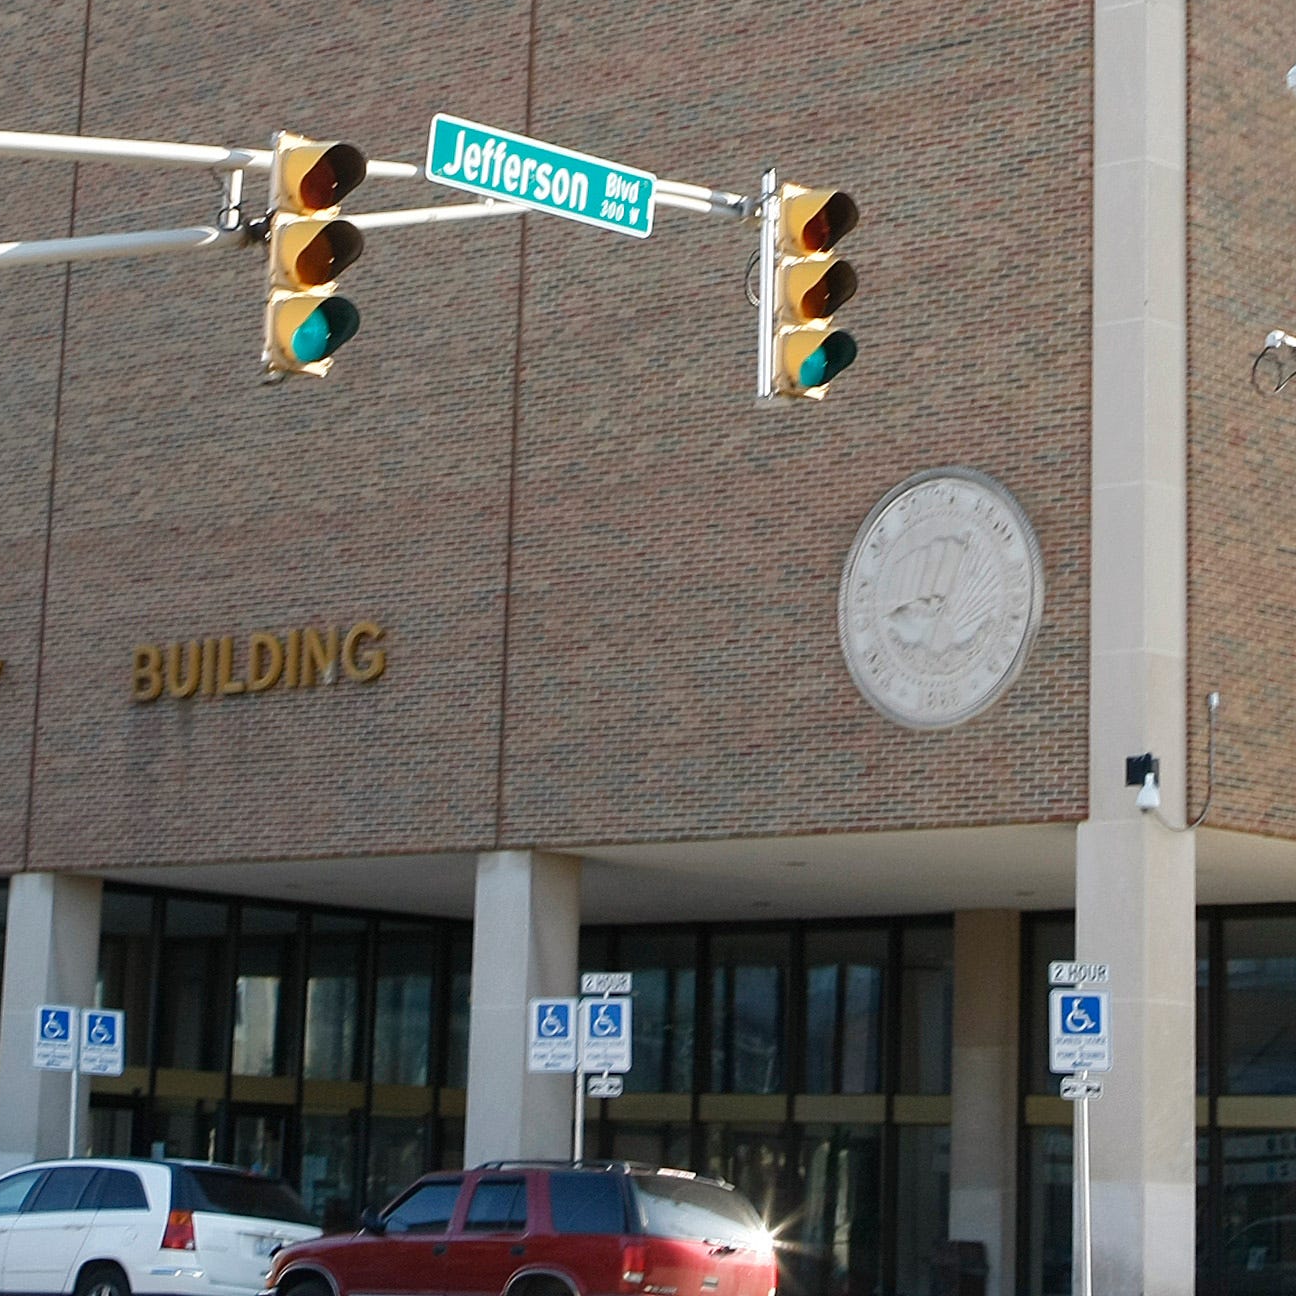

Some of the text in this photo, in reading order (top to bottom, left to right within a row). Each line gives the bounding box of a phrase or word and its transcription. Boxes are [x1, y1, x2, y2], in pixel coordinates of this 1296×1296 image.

[443, 130, 640, 211] Jefferson Blvd
[132, 621, 387, 702] BUILDING
[1054, 963, 1107, 983] 2 HOUR
